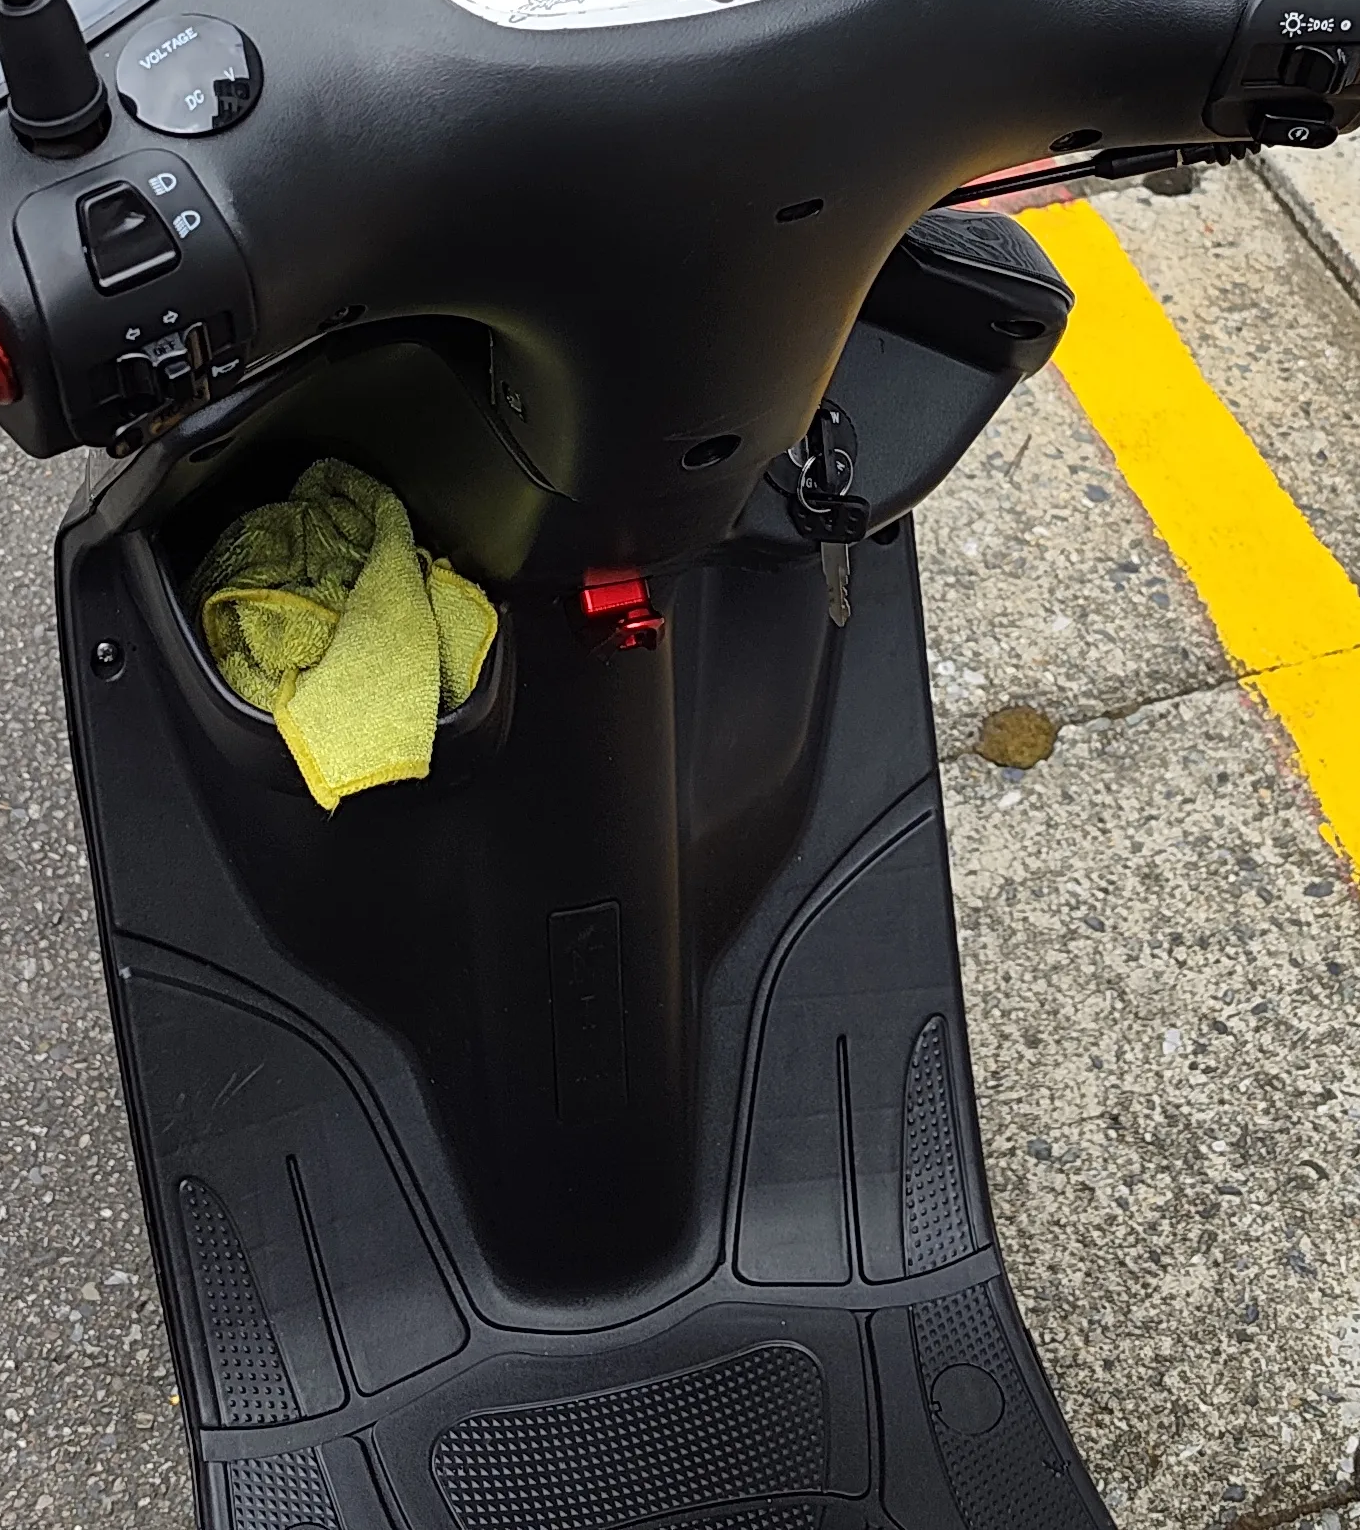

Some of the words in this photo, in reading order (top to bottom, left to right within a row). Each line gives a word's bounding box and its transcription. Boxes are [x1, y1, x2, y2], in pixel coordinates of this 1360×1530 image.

[139, 26, 198, 69] VOLTAGE
[223, 67, 235, 82] V
[184, 89, 205, 111] DC
